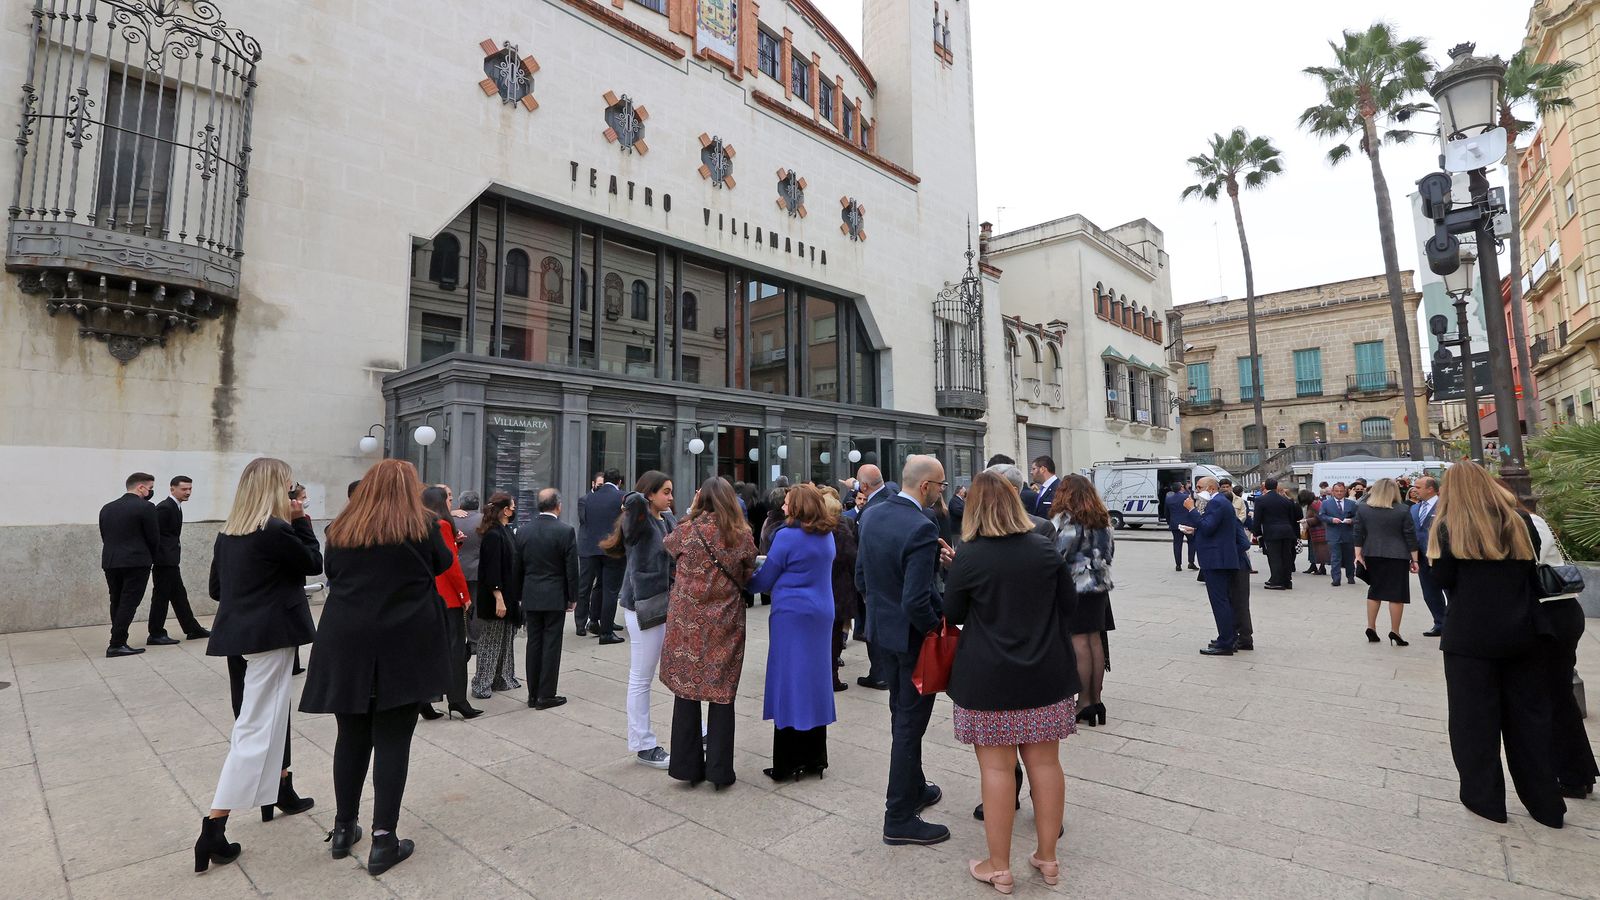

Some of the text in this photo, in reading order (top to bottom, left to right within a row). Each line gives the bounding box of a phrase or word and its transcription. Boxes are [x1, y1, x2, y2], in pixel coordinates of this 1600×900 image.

[570, 160, 827, 266] TEATRO VILLAMARTA
[493, 416, 549, 429] VILLAMARTA
